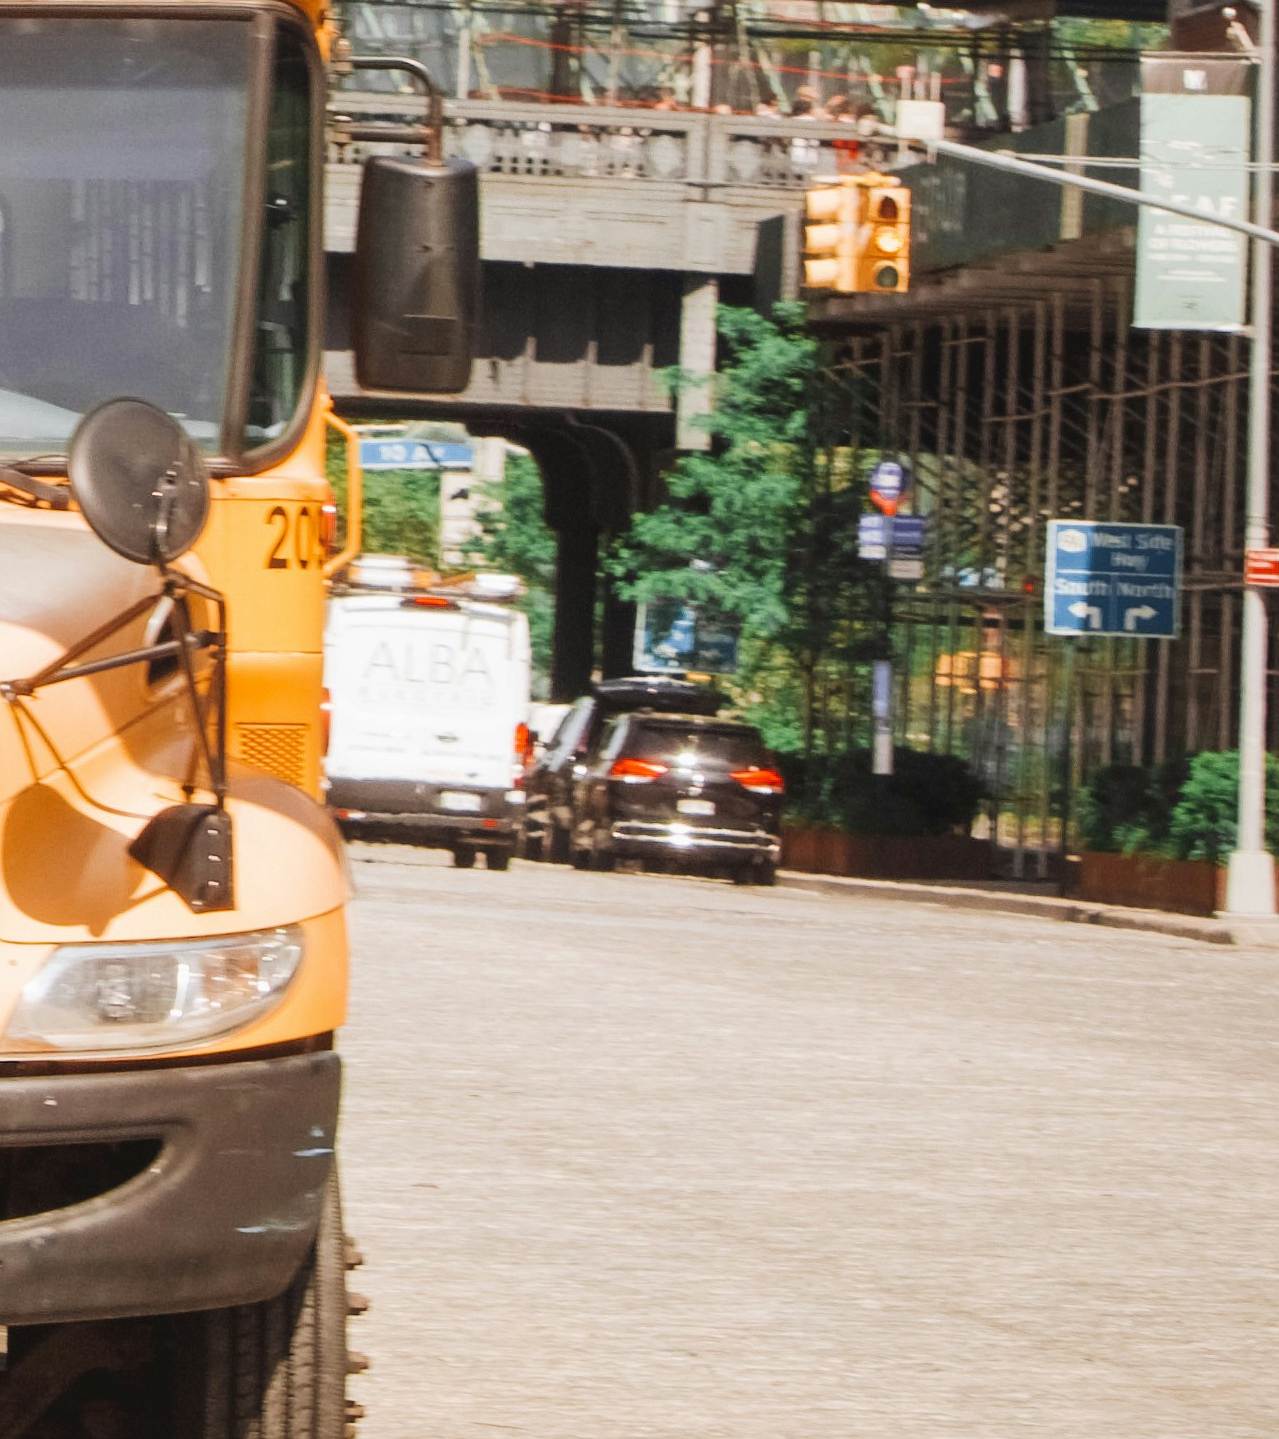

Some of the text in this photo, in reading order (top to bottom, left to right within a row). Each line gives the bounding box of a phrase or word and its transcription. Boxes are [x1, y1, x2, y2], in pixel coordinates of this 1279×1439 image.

[1054, 578, 1173, 598] South North
[362, 641, 497, 687] ALBA
